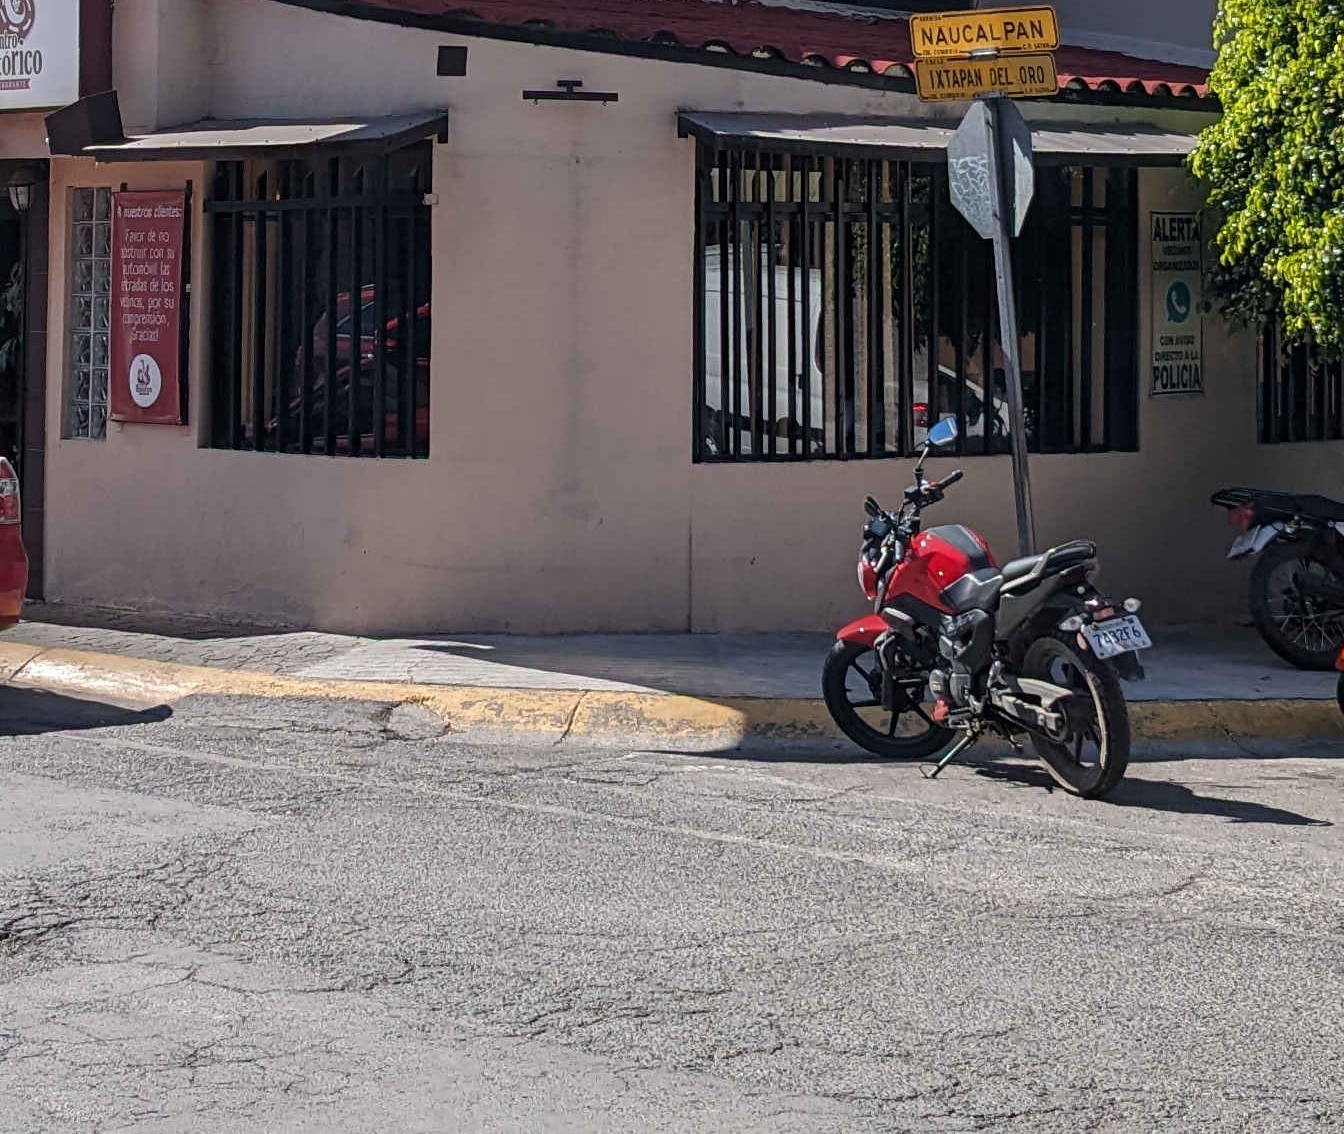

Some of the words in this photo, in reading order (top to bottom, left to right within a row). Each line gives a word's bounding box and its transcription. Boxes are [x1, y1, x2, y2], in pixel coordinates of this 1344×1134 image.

[921, 19, 1044, 46] NAUCALPAN
[929, 67, 983, 90] IXTAPAN
[989, 67, 1014, 86] DEL
[1019, 65, 1045, 84] ORO
[123, 206, 153, 218] nuestros
[125, 229, 145, 242] Favor
[147, 229, 156, 242] de
[158, 231, 170, 242] no
[1153, 217, 1200, 242] ALERTA
[150, 248, 164, 259] con
[167, 249, 175, 259] su
[149, 278, 159, 292] de
[161, 277, 174, 292] los
[164, 298, 174, 309] su
[1155, 351, 1183, 362] DIRECTO
[1184, 351, 1190, 361] A
[1191, 350, 1200, 361] LA
[1153, 365, 1200, 391] POLICIA
